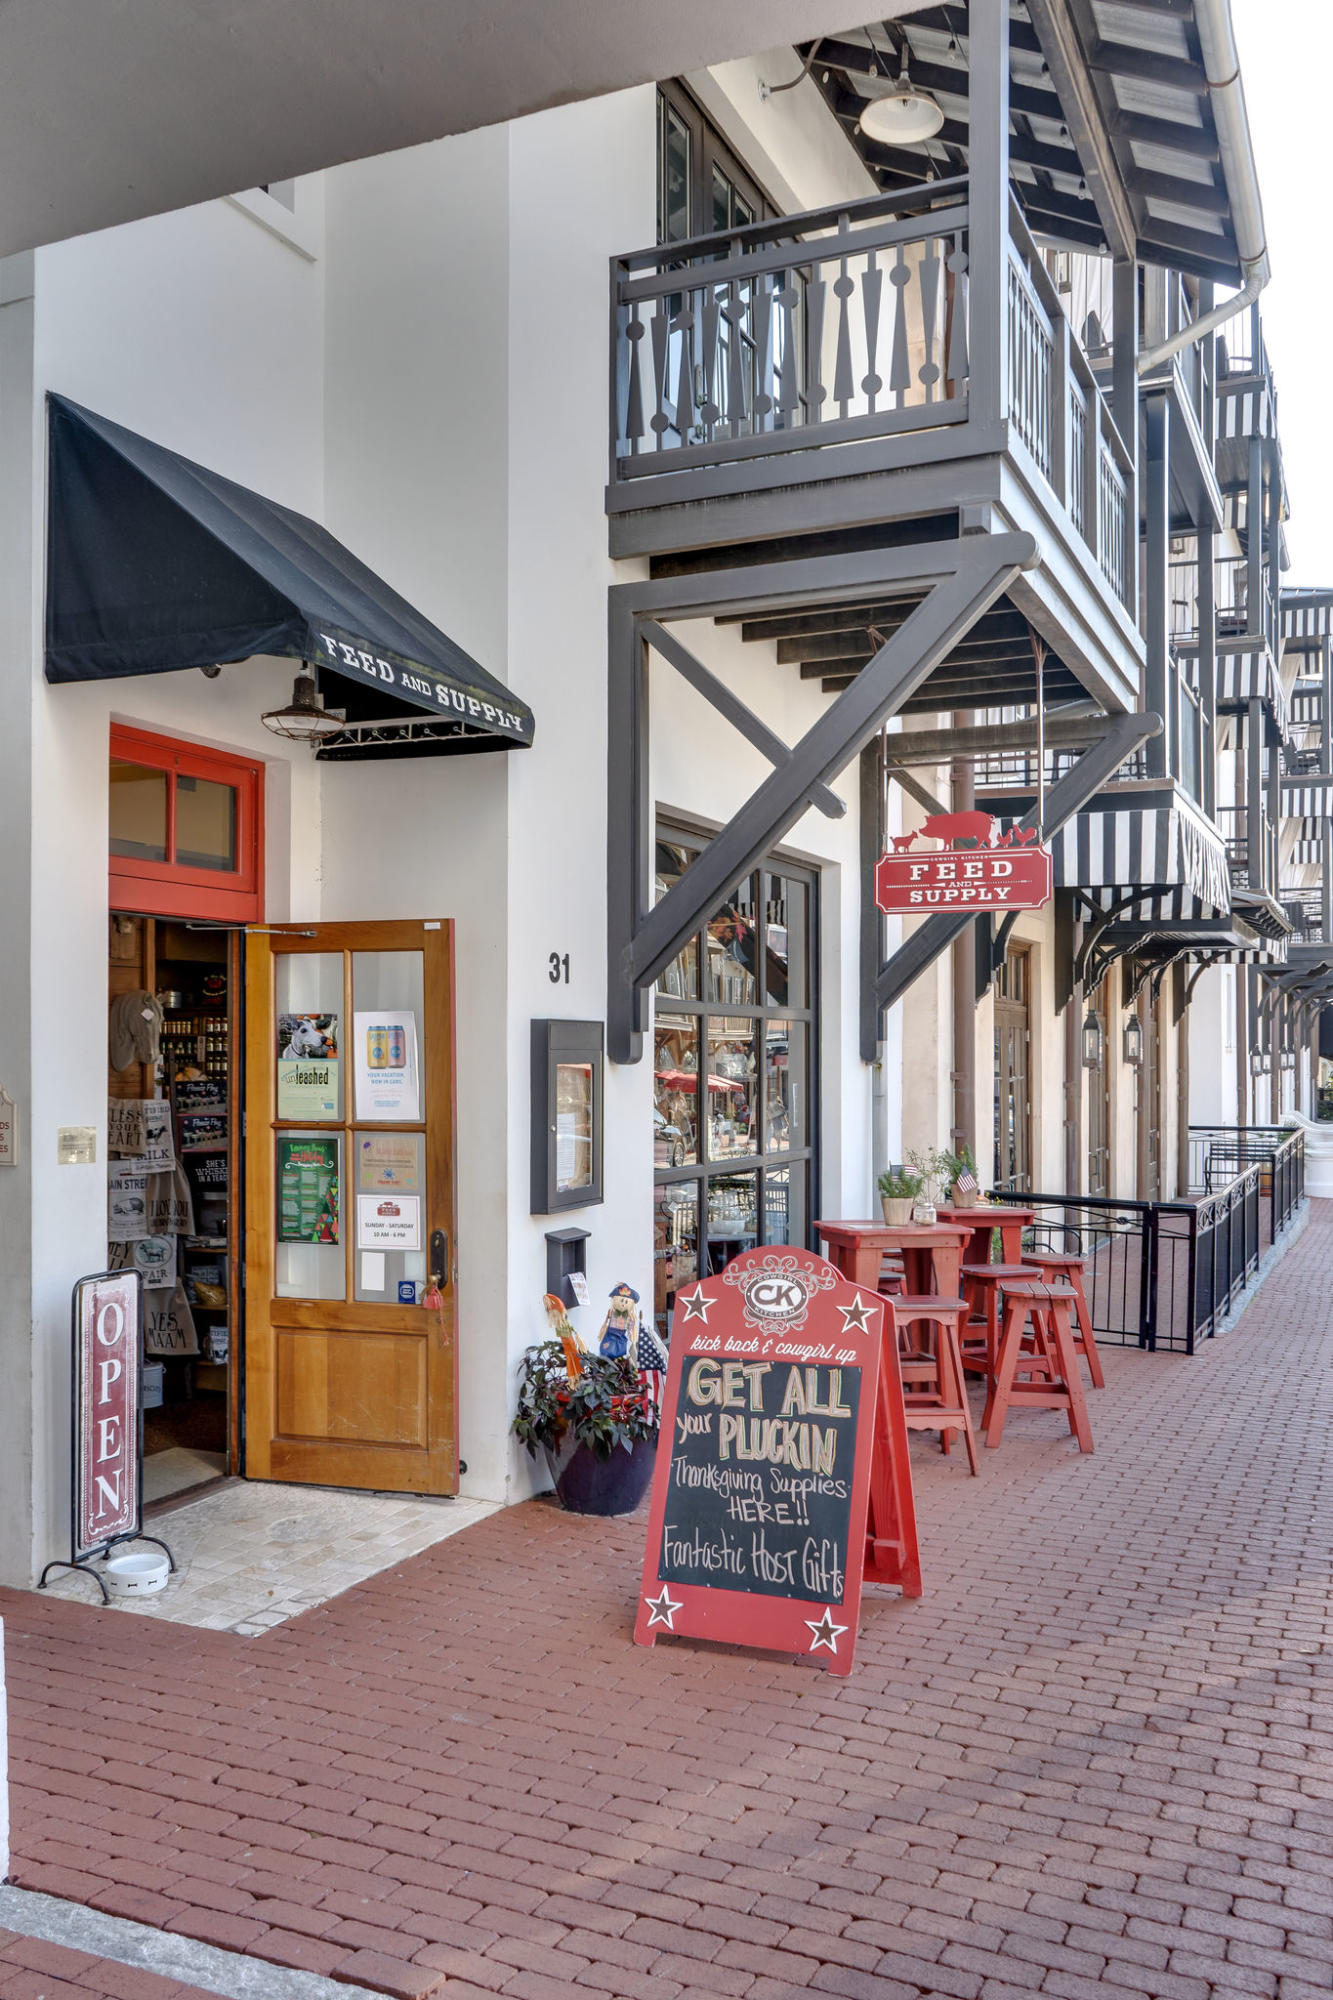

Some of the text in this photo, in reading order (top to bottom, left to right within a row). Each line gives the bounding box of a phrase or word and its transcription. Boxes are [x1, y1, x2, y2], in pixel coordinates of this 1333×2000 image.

[320, 633, 523, 732] FEED AND SUPPLY
[909, 860, 1013, 881] FEED
[948, 880, 973, 888] AND
[909, 886, 1012, 904] SUPPLY
[549, 952, 570, 984] 31
[110, 1109, 144, 1123] LESS
[108, 1131, 143, 1145] EART
[109, 1178, 147, 1190] AIN STRE
[143, 1269, 168, 1279] FAIR
[756, 1273, 800, 1285] COWGIRL
[754, 1284, 796, 1306] CK
[151, 1311, 178, 1331] YES
[754, 1306, 796, 1317] KITCHEN
[690, 1335, 721, 1351] kick
[724, 1336, 759, 1353] back
[775, 1343, 836, 1361] cowgirl
[836, 1349, 857, 1364] up
[688, 1357, 852, 1417] GET ALL
[95, 1302, 124, 1519] OPEN
[676, 1412, 838, 1477] your PLUCKIN
[673, 1455, 848, 1503] Thanksgiving Supplies
[726, 1496, 810, 1526] HERE!!
[664, 1525, 746, 1575] Fantastic
[802, 1536, 845, 1598] Gifts
